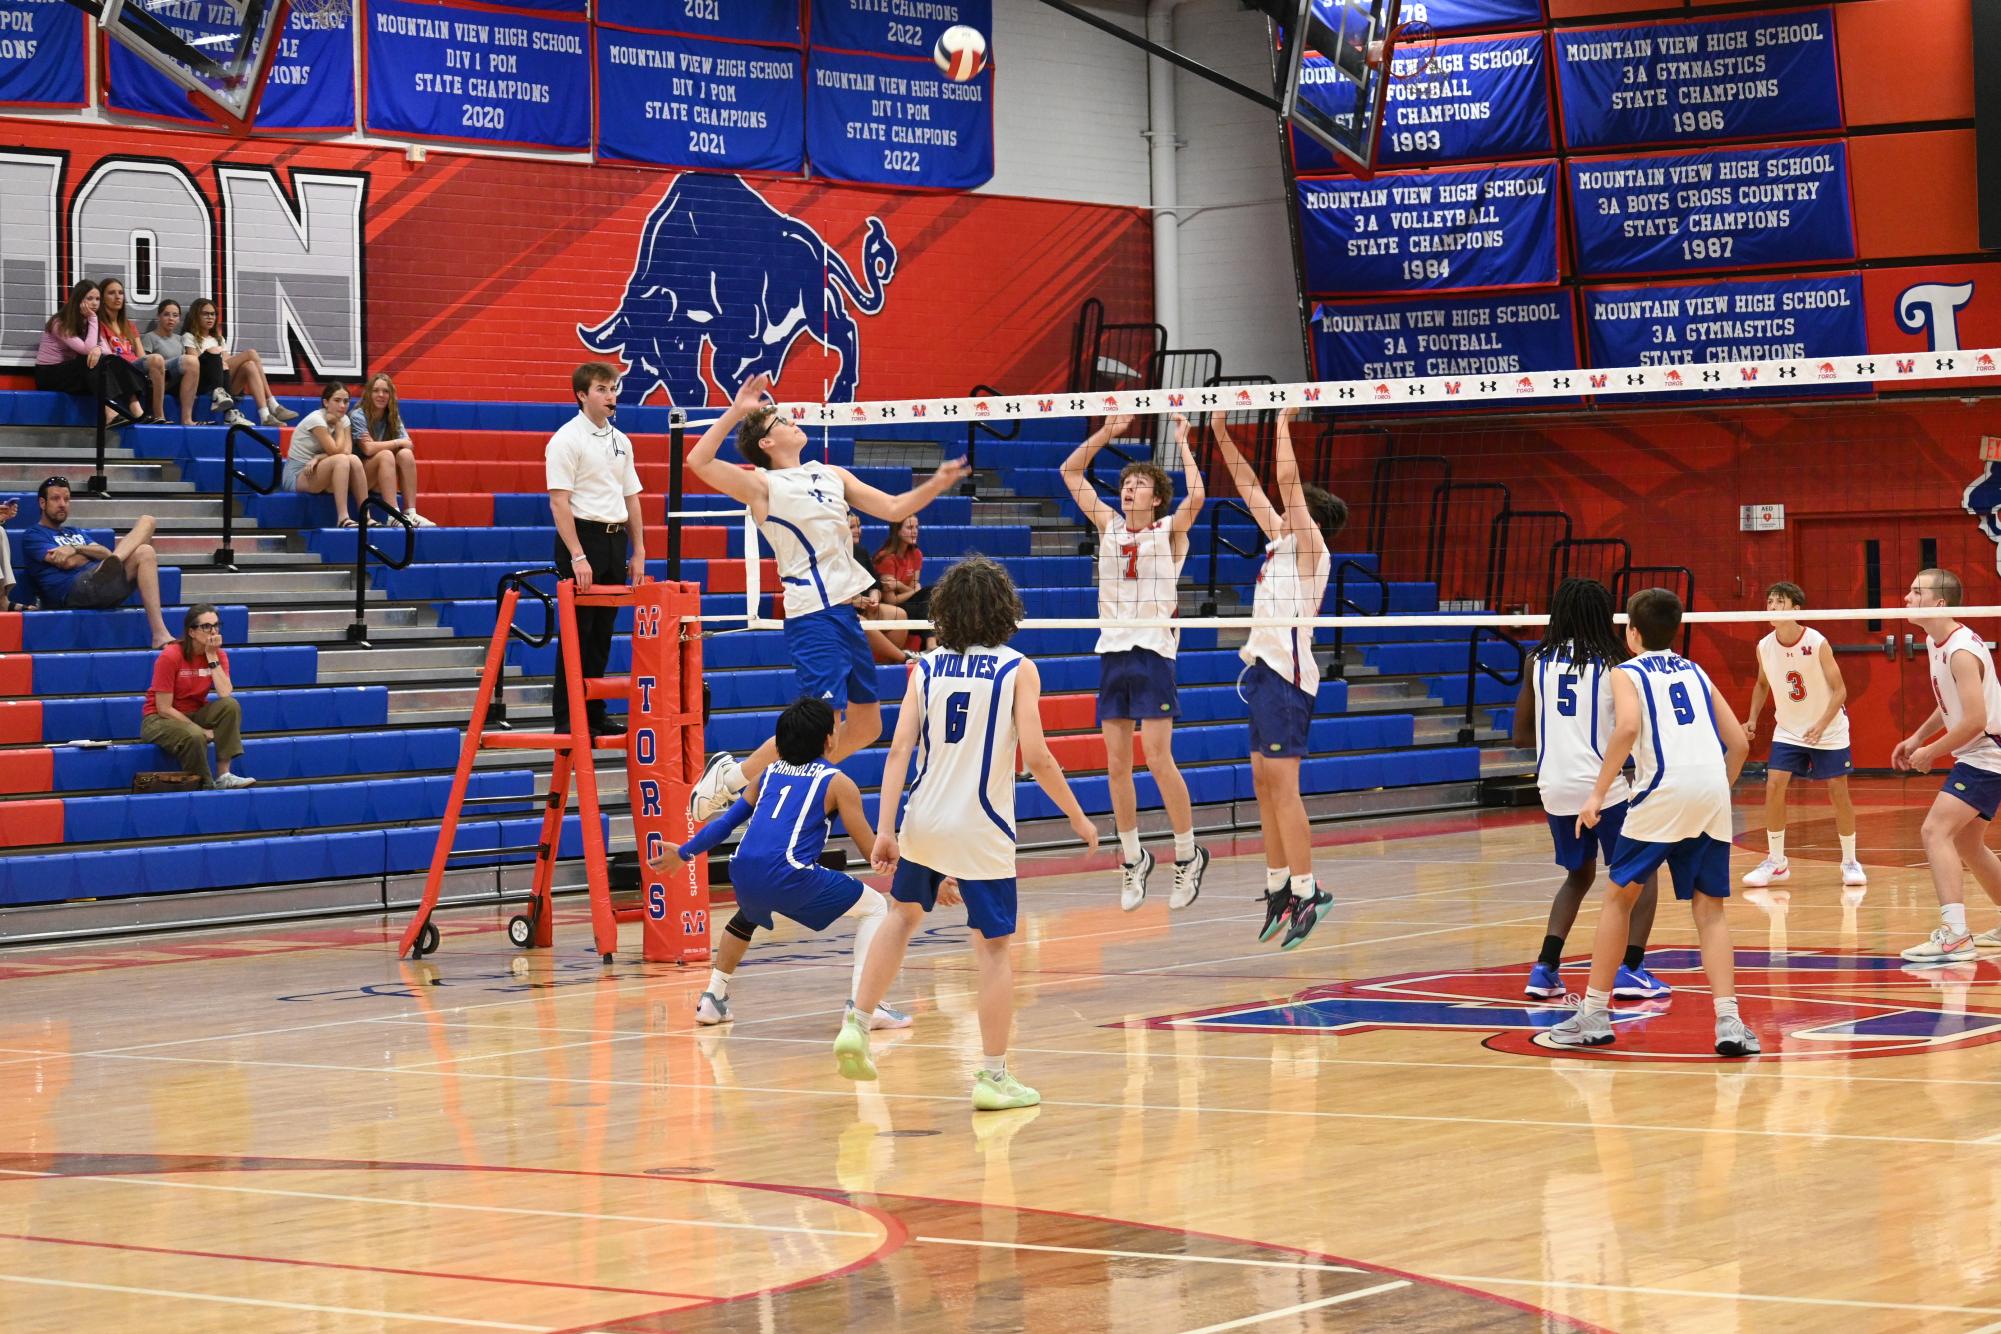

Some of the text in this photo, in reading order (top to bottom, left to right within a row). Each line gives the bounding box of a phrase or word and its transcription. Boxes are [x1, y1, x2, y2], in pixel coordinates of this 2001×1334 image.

[892, 0, 958, 21] CHAMPIONS
[377, 13, 582, 54] MOUNTAIN VIEW HIGH SCHOOL
[888, 22, 922, 45] 2022
[1567, 23, 1823, 61] MOUNTAIN VIEW HIGH SCHOOL
[447, 49, 516, 73] DIV 1 POM
[610, 46, 675, 68] MOUNTAIN
[680, 54, 712, 74] VIEW
[716, 59, 746, 77] HIGH
[1470, 48, 1533, 70] SCHOOL
[1623, 55, 1765, 83] 3A GYMNASTICS
[416, 74, 549, 103] STATE CHAMPIONS
[673, 78, 736, 102] DIV 1 POM
[816, 69, 875, 91] MOUNTAIN
[879, 77, 906, 95] VIEW
[911, 81, 938, 97] HIGH
[1612, 79, 1778, 109] STATE CHAMPIONS
[463, 105, 504, 129] 2020
[646, 102, 767, 128] STATE CHAMPIONS
[872, 100, 930, 120] DIV 1 POM
[1397, 102, 1490, 124] CHAMPIONS
[1673, 110, 1724, 132] 1986
[689, 131, 725, 154] 2021
[847, 122, 957, 146] STATE CHAMPIONS
[885, 150, 920, 171] 2022
[1579, 155, 1834, 189] MOUNTAIN VIEW HIGH SCHOOL
[1307, 178, 1546, 209] MOUNTAIN VIEW HIGH SCHOOL
[1599, 182, 1819, 214] 3A BOYS CROSS COUNTRY
[1355, 206, 1499, 232] 3A VOLLEYBALL
[1624, 210, 1789, 237] STATE CHAMPIONS
[1348, 230, 1503, 256] STATE CHAMPIONS
[1683, 237, 1733, 259] 1987
[1403, 259, 1449, 279] 1984
[1322, 303, 1560, 332] MOUNTAIN VIEW HIGH SCHOOL
[1595, 289, 1850, 320] MOUNTAIN VIEW HIGH SCHOOL
[1653, 318, 1794, 343] 3A GYMNASTICS
[1384, 333, 1501, 355] 3A FOOTBALL
[1639, 342, 1806, 367] STATE CHAMPIONS
[1362, 354, 1521, 380] STATE CHAMPIONS
[1120, 544, 1139, 581] 7
[932, 653, 998, 680] WOLVES
[1557, 674, 1578, 717] 5
[1785, 671, 1808, 702] 3
[1668, 681, 1696, 725] 9
[944, 691, 971, 744] 6
[769, 758, 825, 778] CHANDLER
[770, 784, 792, 820] 1
